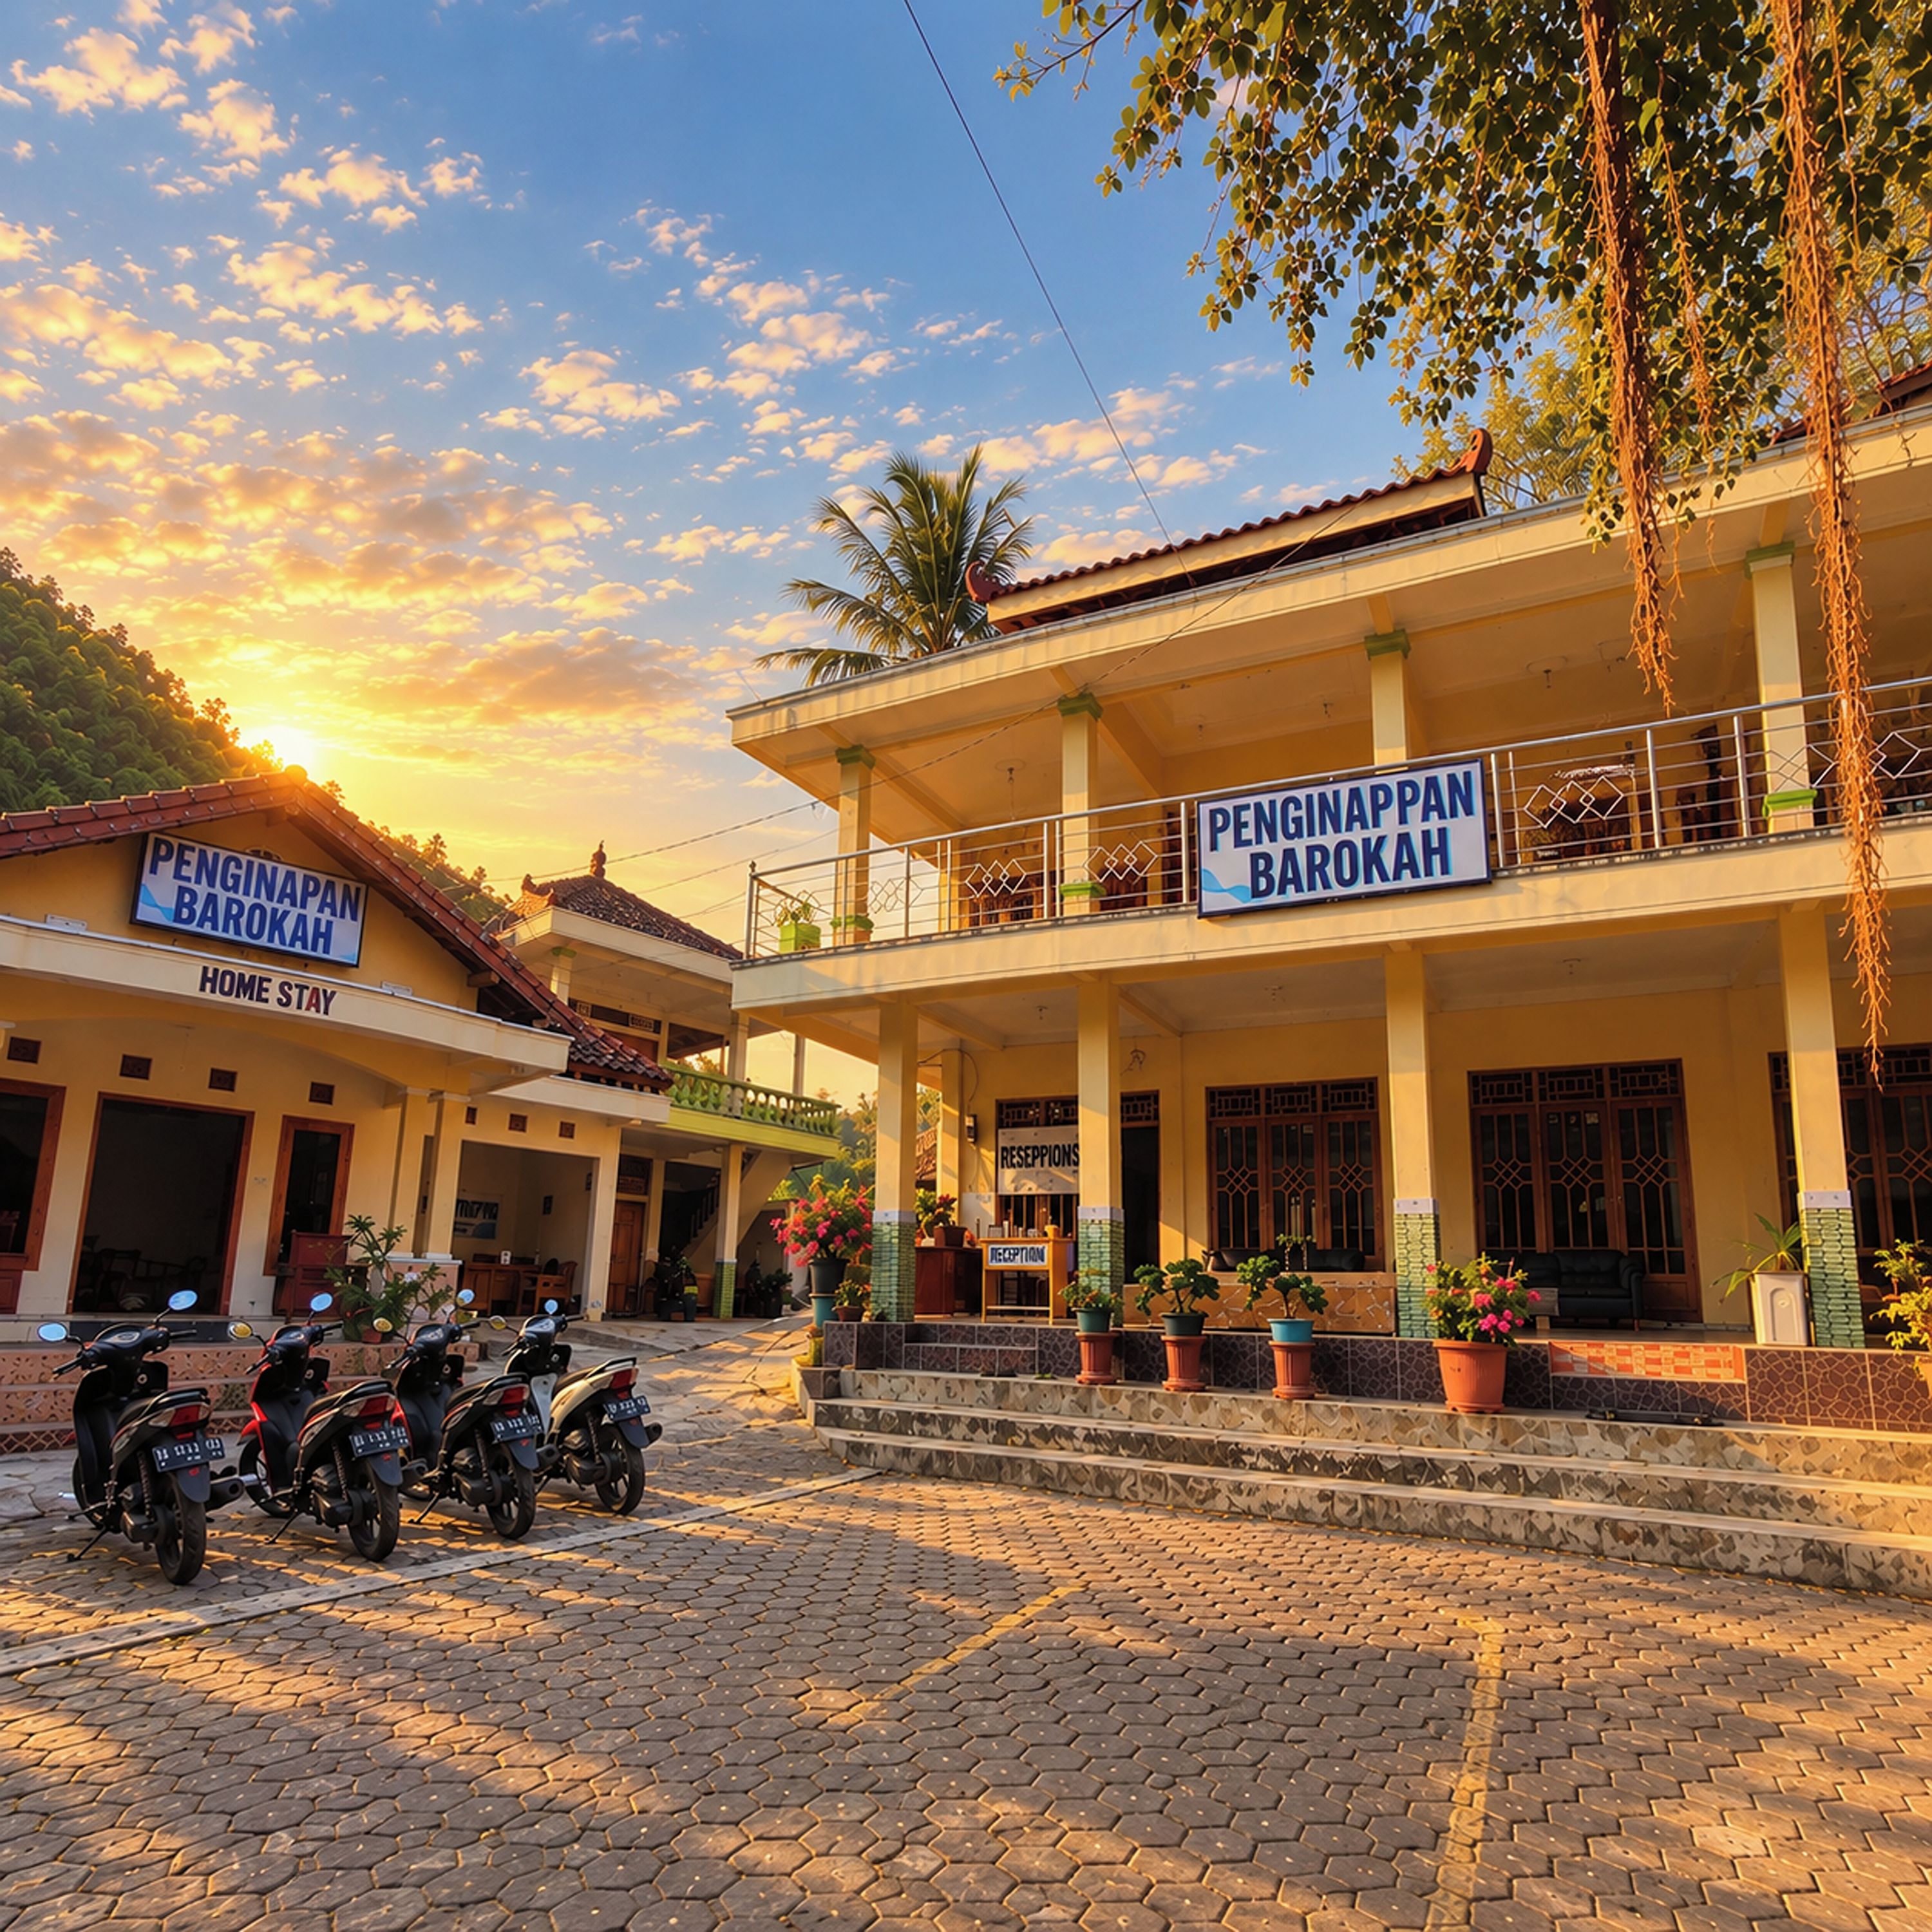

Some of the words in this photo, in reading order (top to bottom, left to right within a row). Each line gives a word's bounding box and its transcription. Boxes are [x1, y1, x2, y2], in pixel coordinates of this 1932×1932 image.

[1209, 770, 1473, 851] PENGINAPPAN
[149, 838, 361, 922] PENGINAPAN
[1251, 827, 1452, 899] BAROKAH
[174, 886, 334, 955] BAROKAH
[199, 966, 272, 1004] HOME
[276, 980, 337, 1016] STAY
[1001, 1143, 1079, 1169] RESEPPIONS
